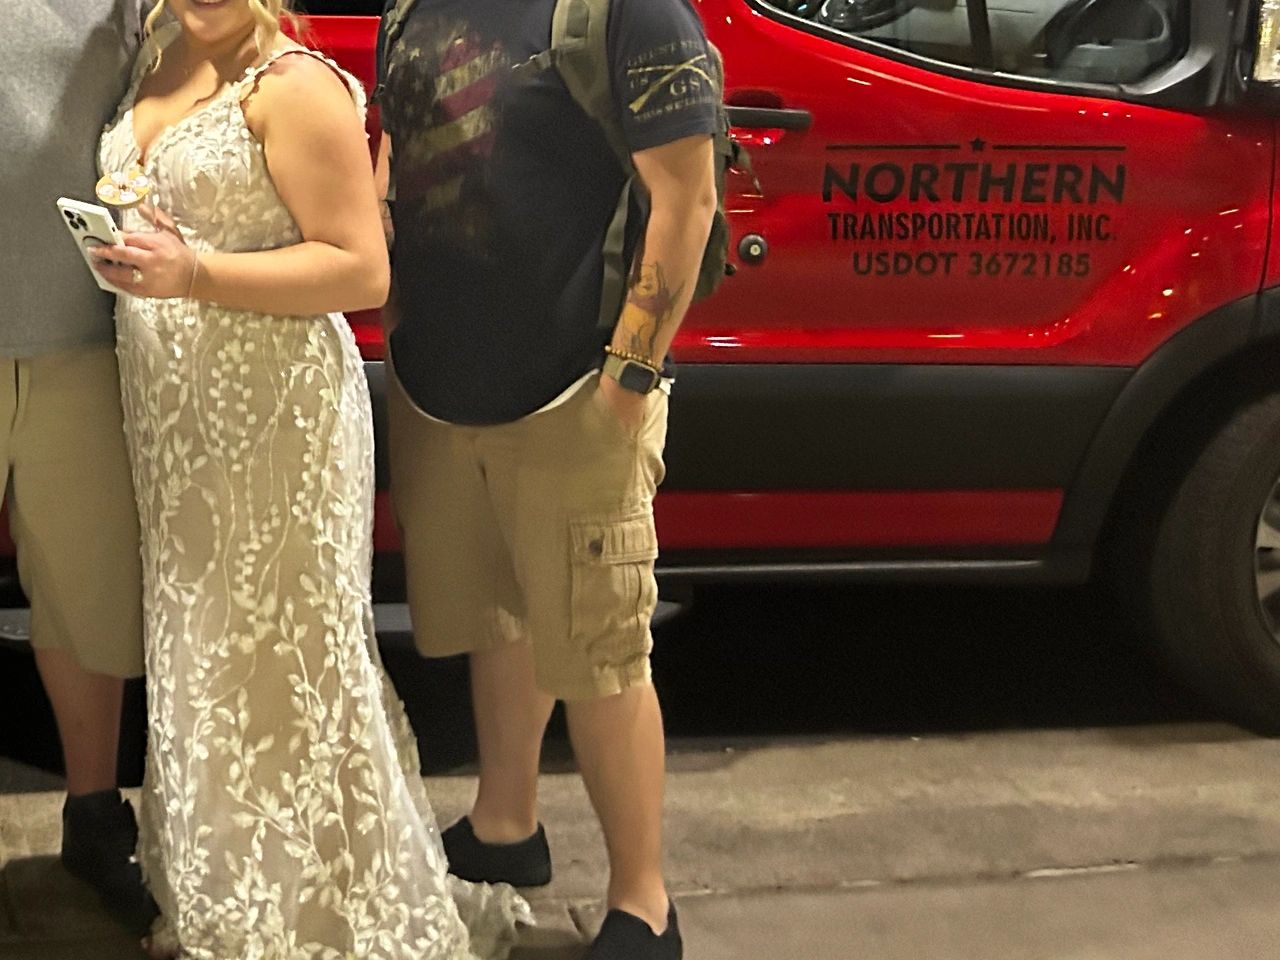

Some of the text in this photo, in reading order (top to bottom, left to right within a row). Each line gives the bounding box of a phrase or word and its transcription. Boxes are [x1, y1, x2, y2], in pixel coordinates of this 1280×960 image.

[822, 162, 1127, 204] NORTHERN
[827, 212, 1118, 244] TRANSPORTATION, INC.
[852, 251, 1090, 278] USDOT 3672185
